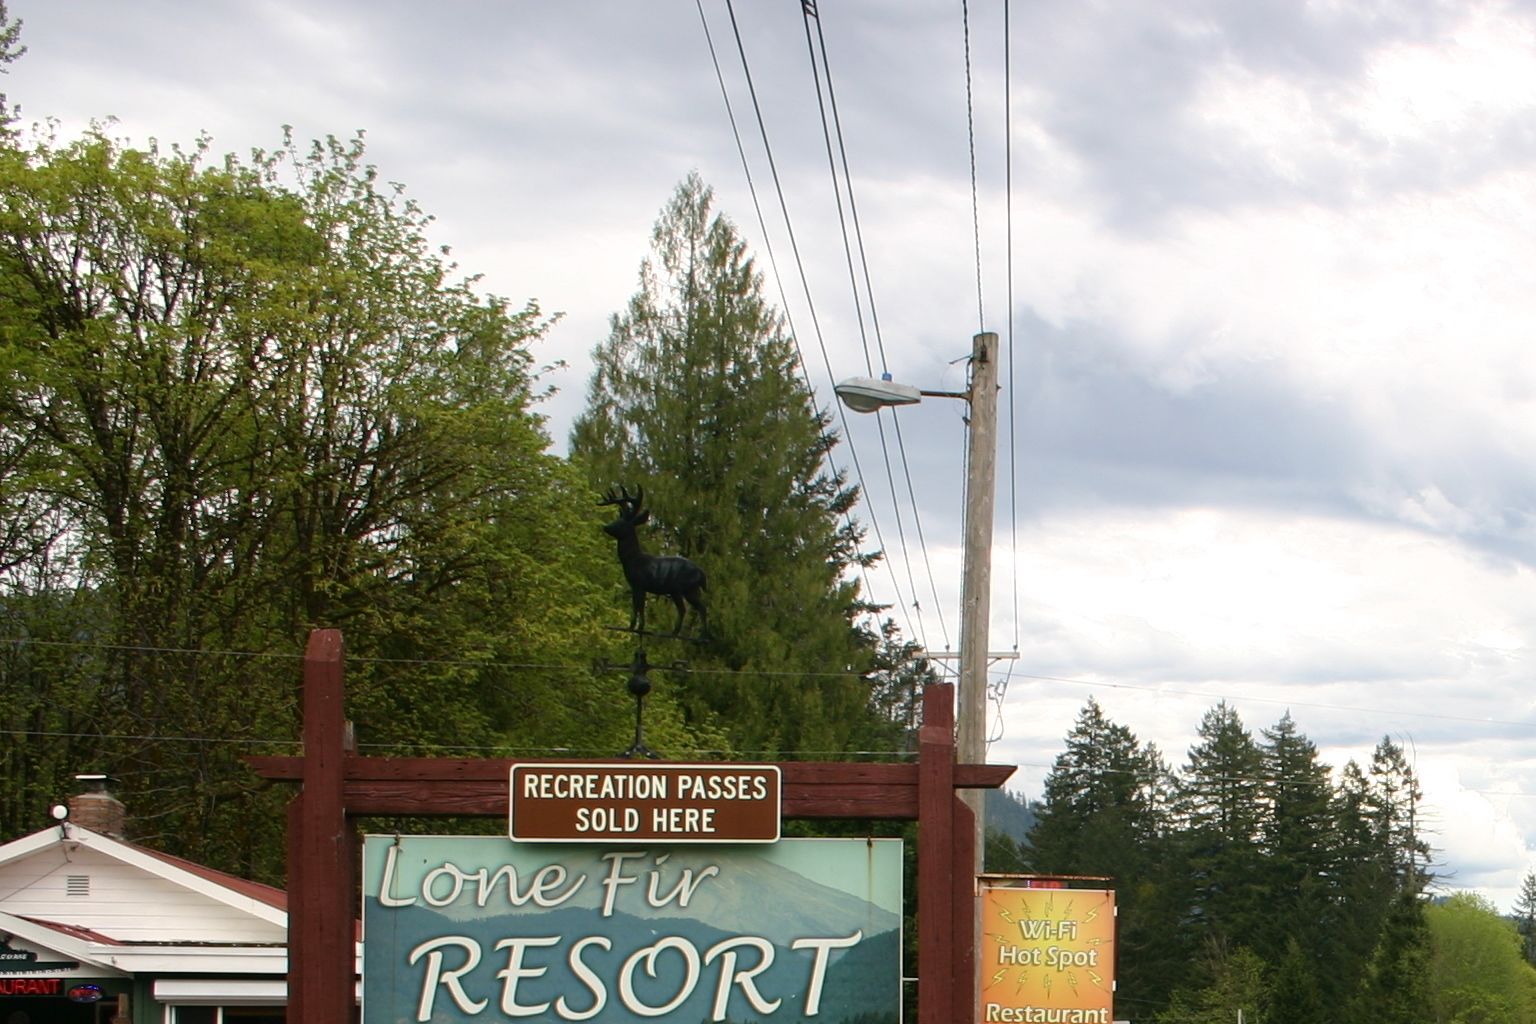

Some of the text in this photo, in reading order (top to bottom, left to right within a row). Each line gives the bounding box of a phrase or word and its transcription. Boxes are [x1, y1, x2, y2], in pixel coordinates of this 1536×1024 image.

[523, 774, 768, 801] RECREATION PASSES
[575, 808, 717, 833] SOLD HERE
[378, 845, 720, 918] Lone Fir
[1019, 919, 1078, 940] Wi-Fi
[999, 945, 1098, 972] Hot Spot
[408, 930, 863, 1024] RESORT
[985, 1003, 1109, 1024] Restaurant
